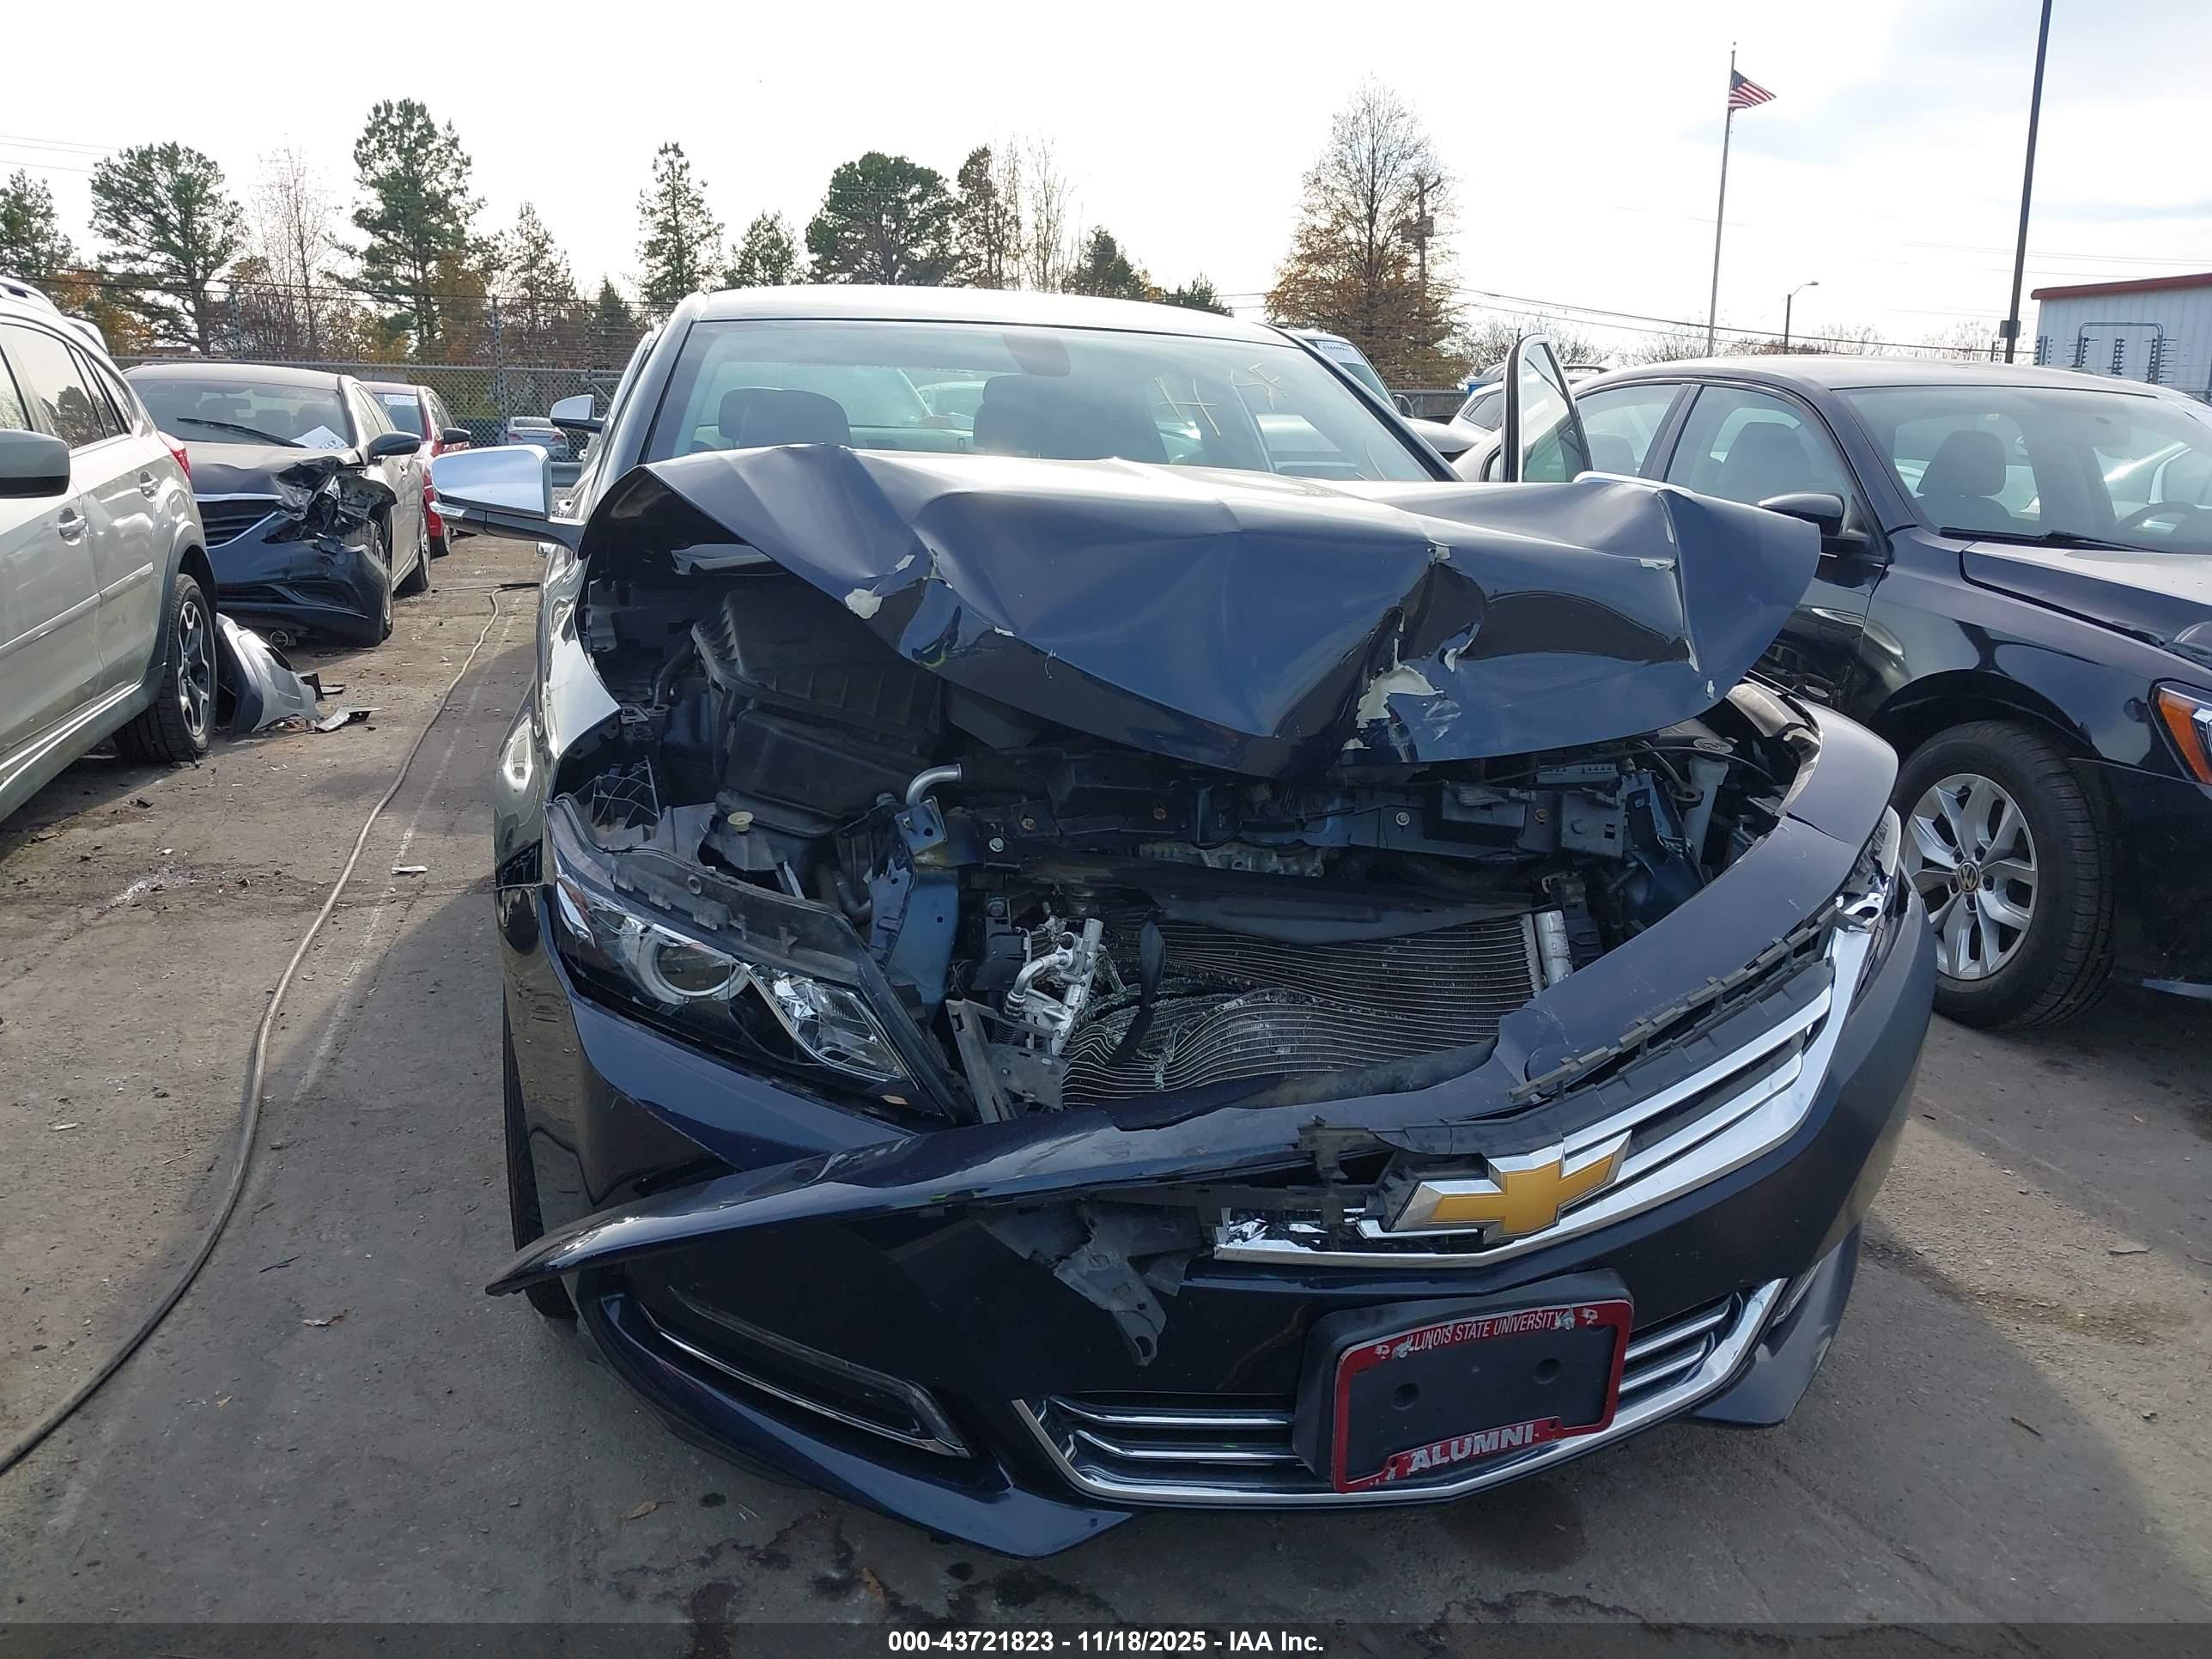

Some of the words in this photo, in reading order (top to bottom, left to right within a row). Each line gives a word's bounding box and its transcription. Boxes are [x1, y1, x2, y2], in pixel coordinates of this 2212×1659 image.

[1406, 1325, 1454, 1352] ILLINOIS
[1455, 1321, 1492, 1341] STATE
[1493, 1311, 1563, 1336] UNIVERSITY
[1409, 1424, 1534, 1474] ALUMNI
